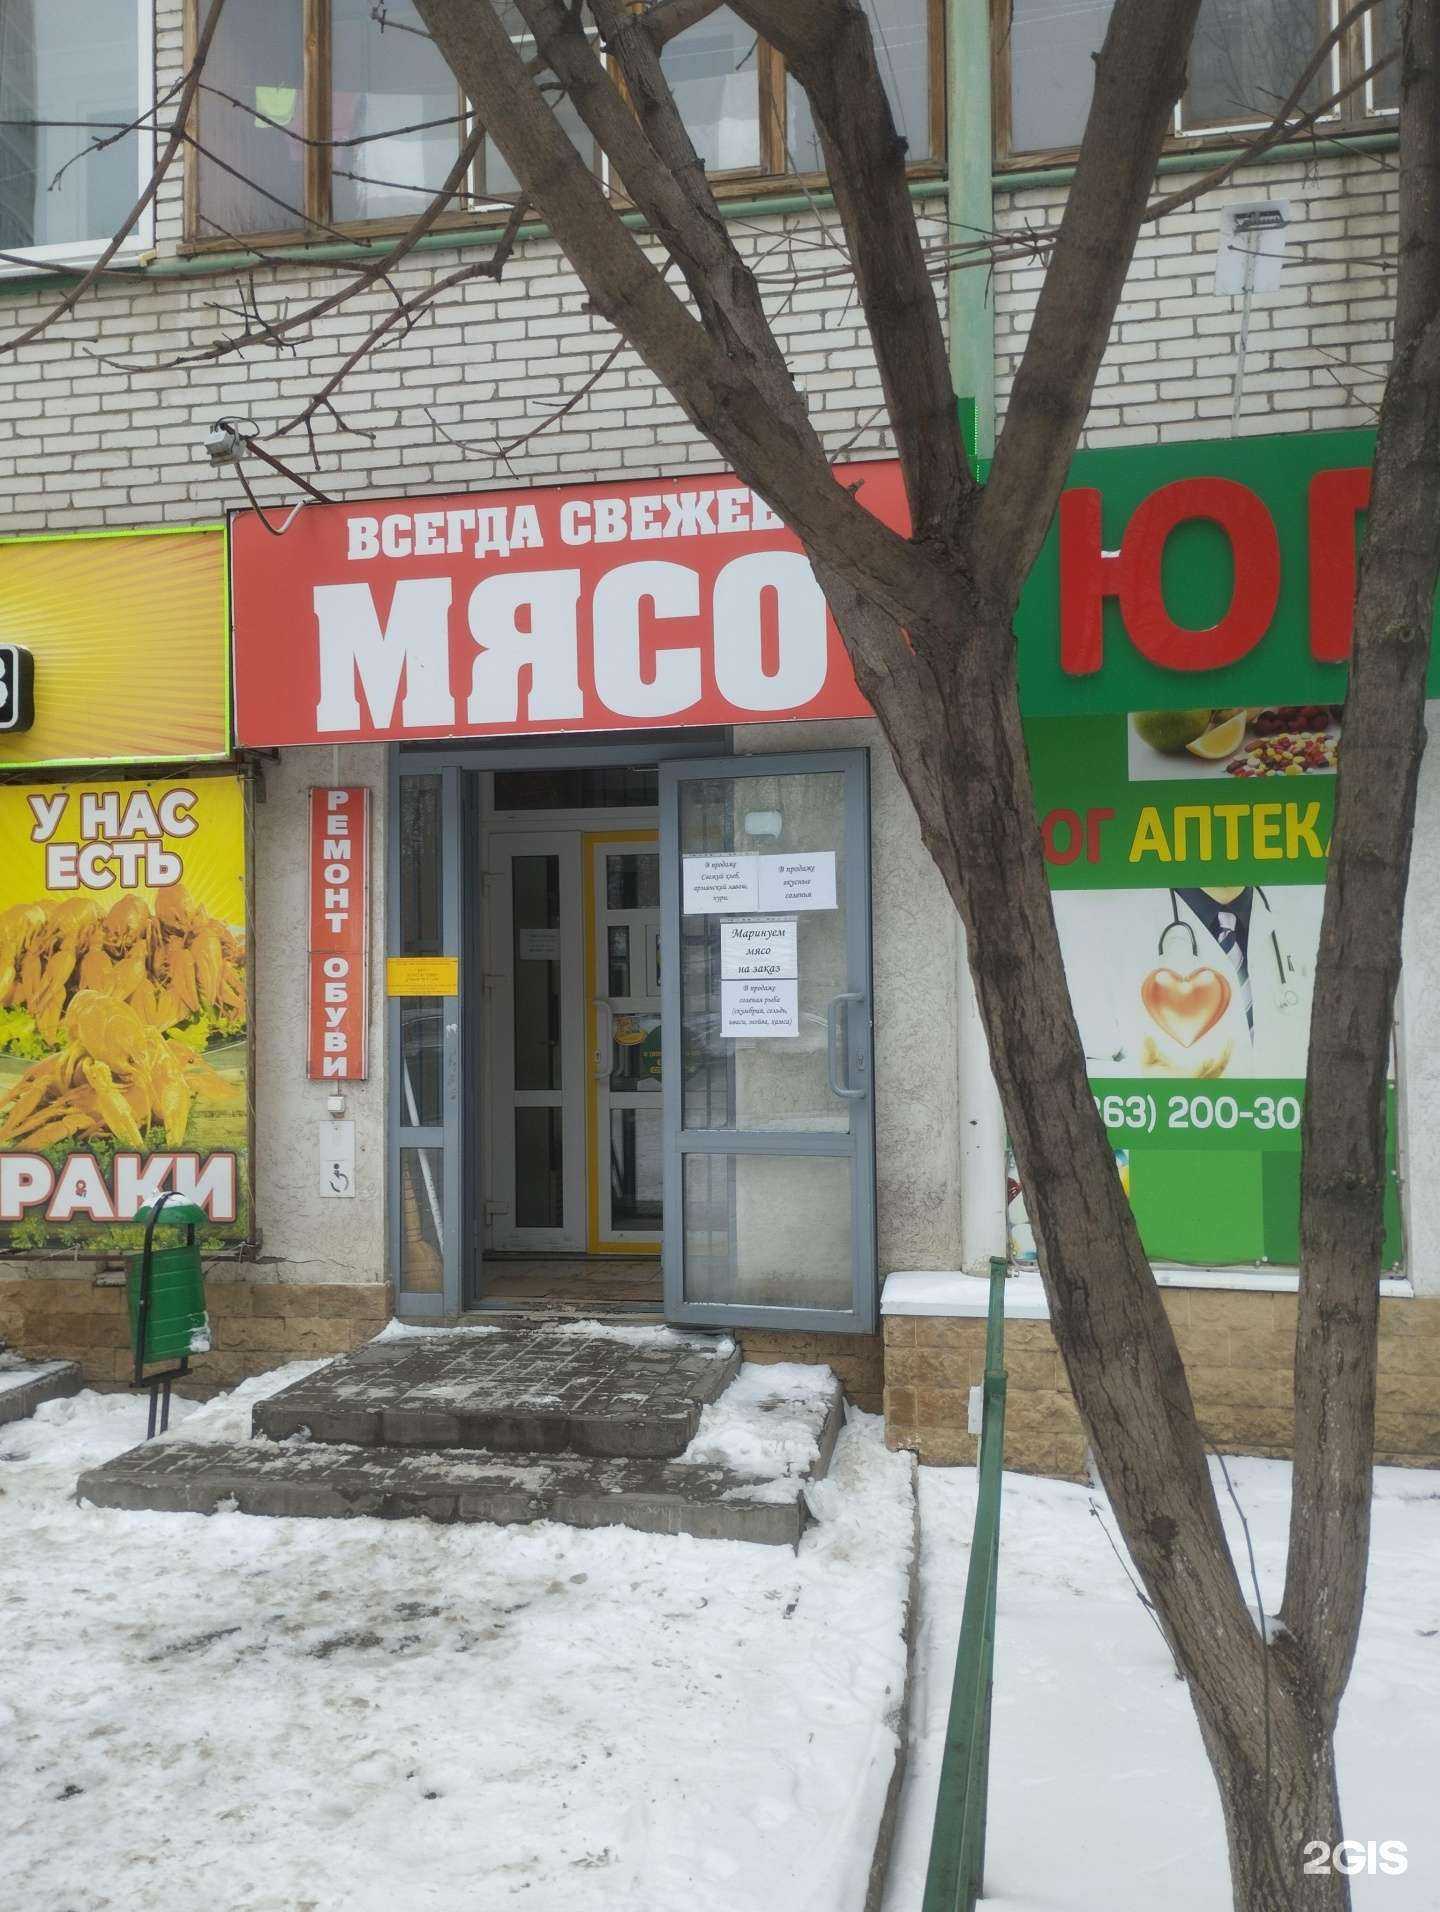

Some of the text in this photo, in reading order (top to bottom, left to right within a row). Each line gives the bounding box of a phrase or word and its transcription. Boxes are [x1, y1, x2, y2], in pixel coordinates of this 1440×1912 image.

[347, 503, 544, 561] ВСЕГДА
[313, 550, 828, 733] МЯСО
[27, 788, 199, 842] У НАС
[1129, 802, 1331, 863] АПТЕК
[46, 839, 183, 891] ЕСТЬ
[323, 790, 352, 934] РЕМОНТ
[732, 928, 786, 940] Маринуем
[746, 947, 771, 955] мясо
[752, 965, 781, 974] заказ
[323, 957, 350, 1077] ОБУВИ
[1093, 1094, 1157, 1133] 63)
[0, 1151, 237, 1222] РАКИ
